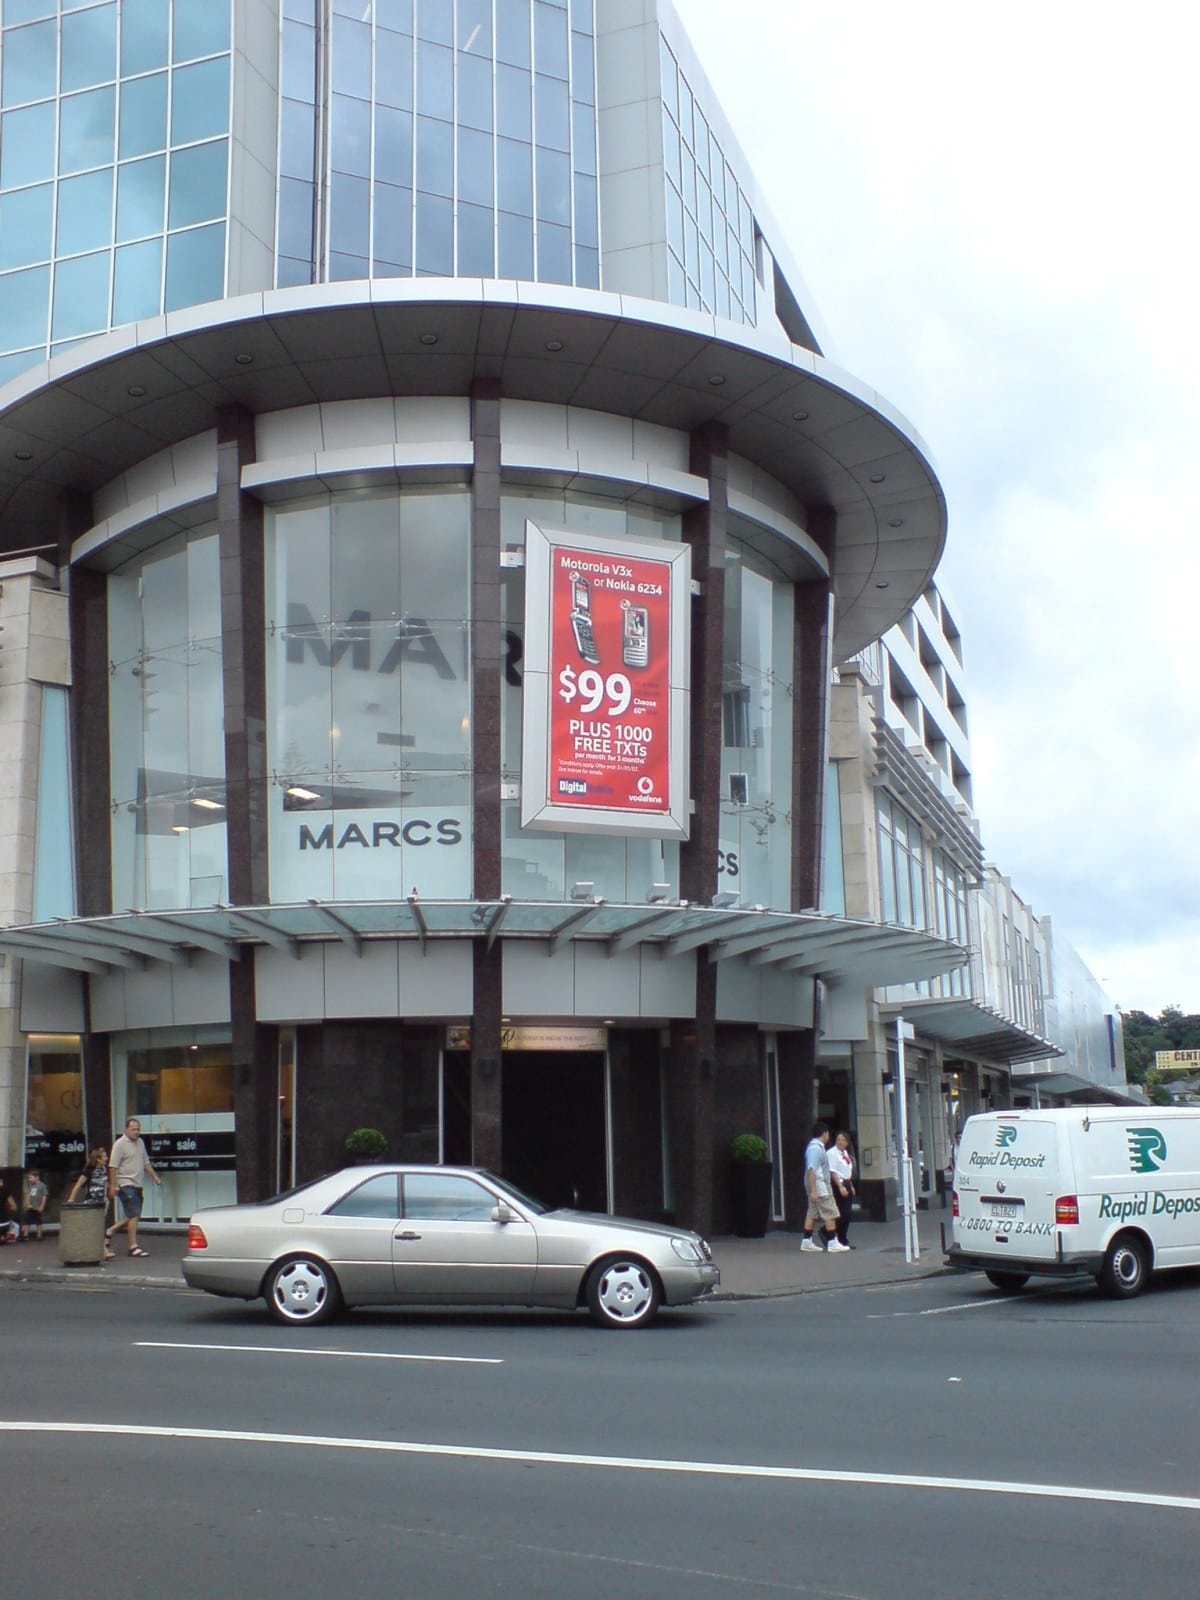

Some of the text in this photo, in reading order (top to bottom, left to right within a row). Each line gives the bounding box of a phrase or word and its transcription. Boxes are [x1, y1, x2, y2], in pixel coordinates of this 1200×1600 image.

[561, 557, 632, 577] Motorola V3x
[594, 578, 662, 595] or Nokia 6234
[559, 664, 632, 716] $99
[569, 719, 653, 743] PLUS 1000
[574, 737, 647, 757] FREE TXTs
[559, 780, 587, 794] Digital
[629, 794, 662, 804] vodafone
[300, 819, 462, 850] MARCS
[58, 1140, 85, 1153] sale
[176, 1138, 197, 1151] sale
[969, 1151, 1046, 1170] Rapid Deposit
[1099, 1191, 1148, 1223] Rapid
[967, 1218, 1055, 1236] 0800 TO BANK
